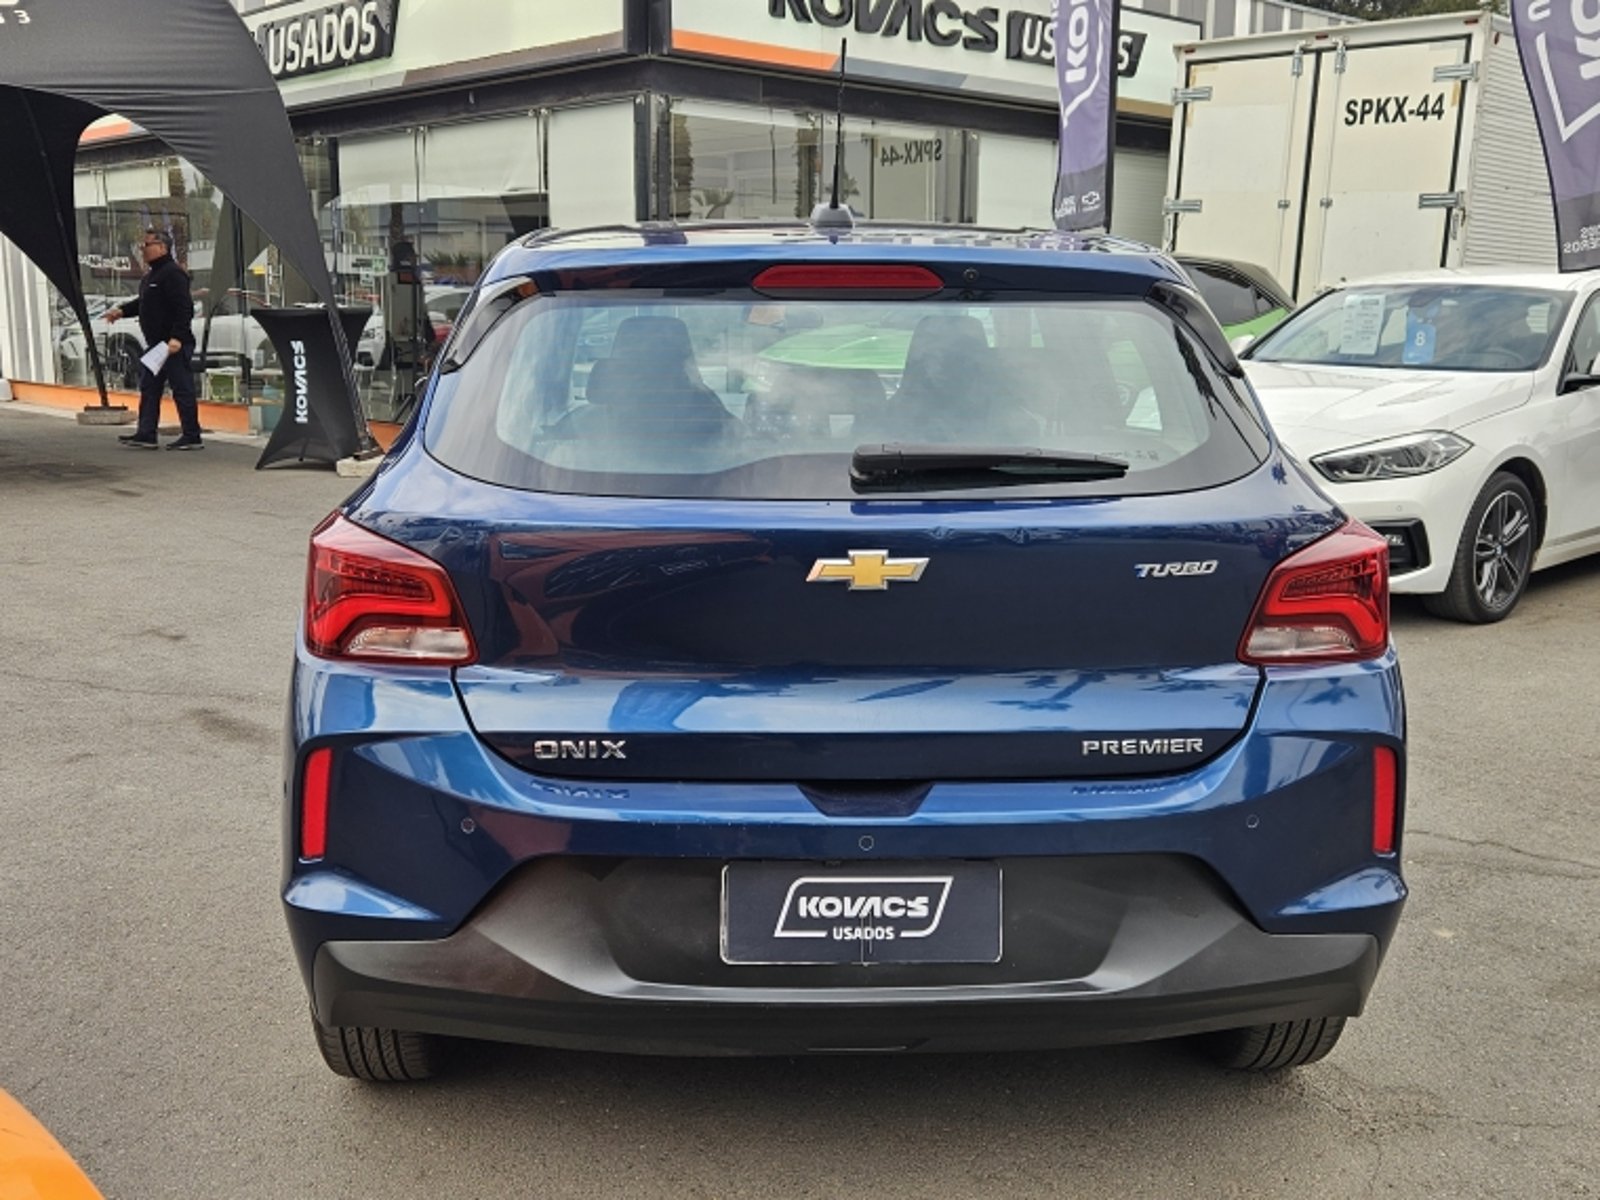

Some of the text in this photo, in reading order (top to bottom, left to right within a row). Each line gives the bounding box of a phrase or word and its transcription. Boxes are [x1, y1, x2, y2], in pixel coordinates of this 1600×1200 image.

[268, 1, 378, 75] USADOS
[1344, 92, 1445, 127] SPKX-44
[1414, 330, 1427, 347] 8
[290, 340, 309, 425] KOVACS
[1133, 559, 1219, 578] TURBO
[533, 739, 627, 760] ONIX
[1081, 737, 1204, 756] PREMIER
[798, 895, 931, 919] KOVACS
[832, 926, 896, 941] USADOS
